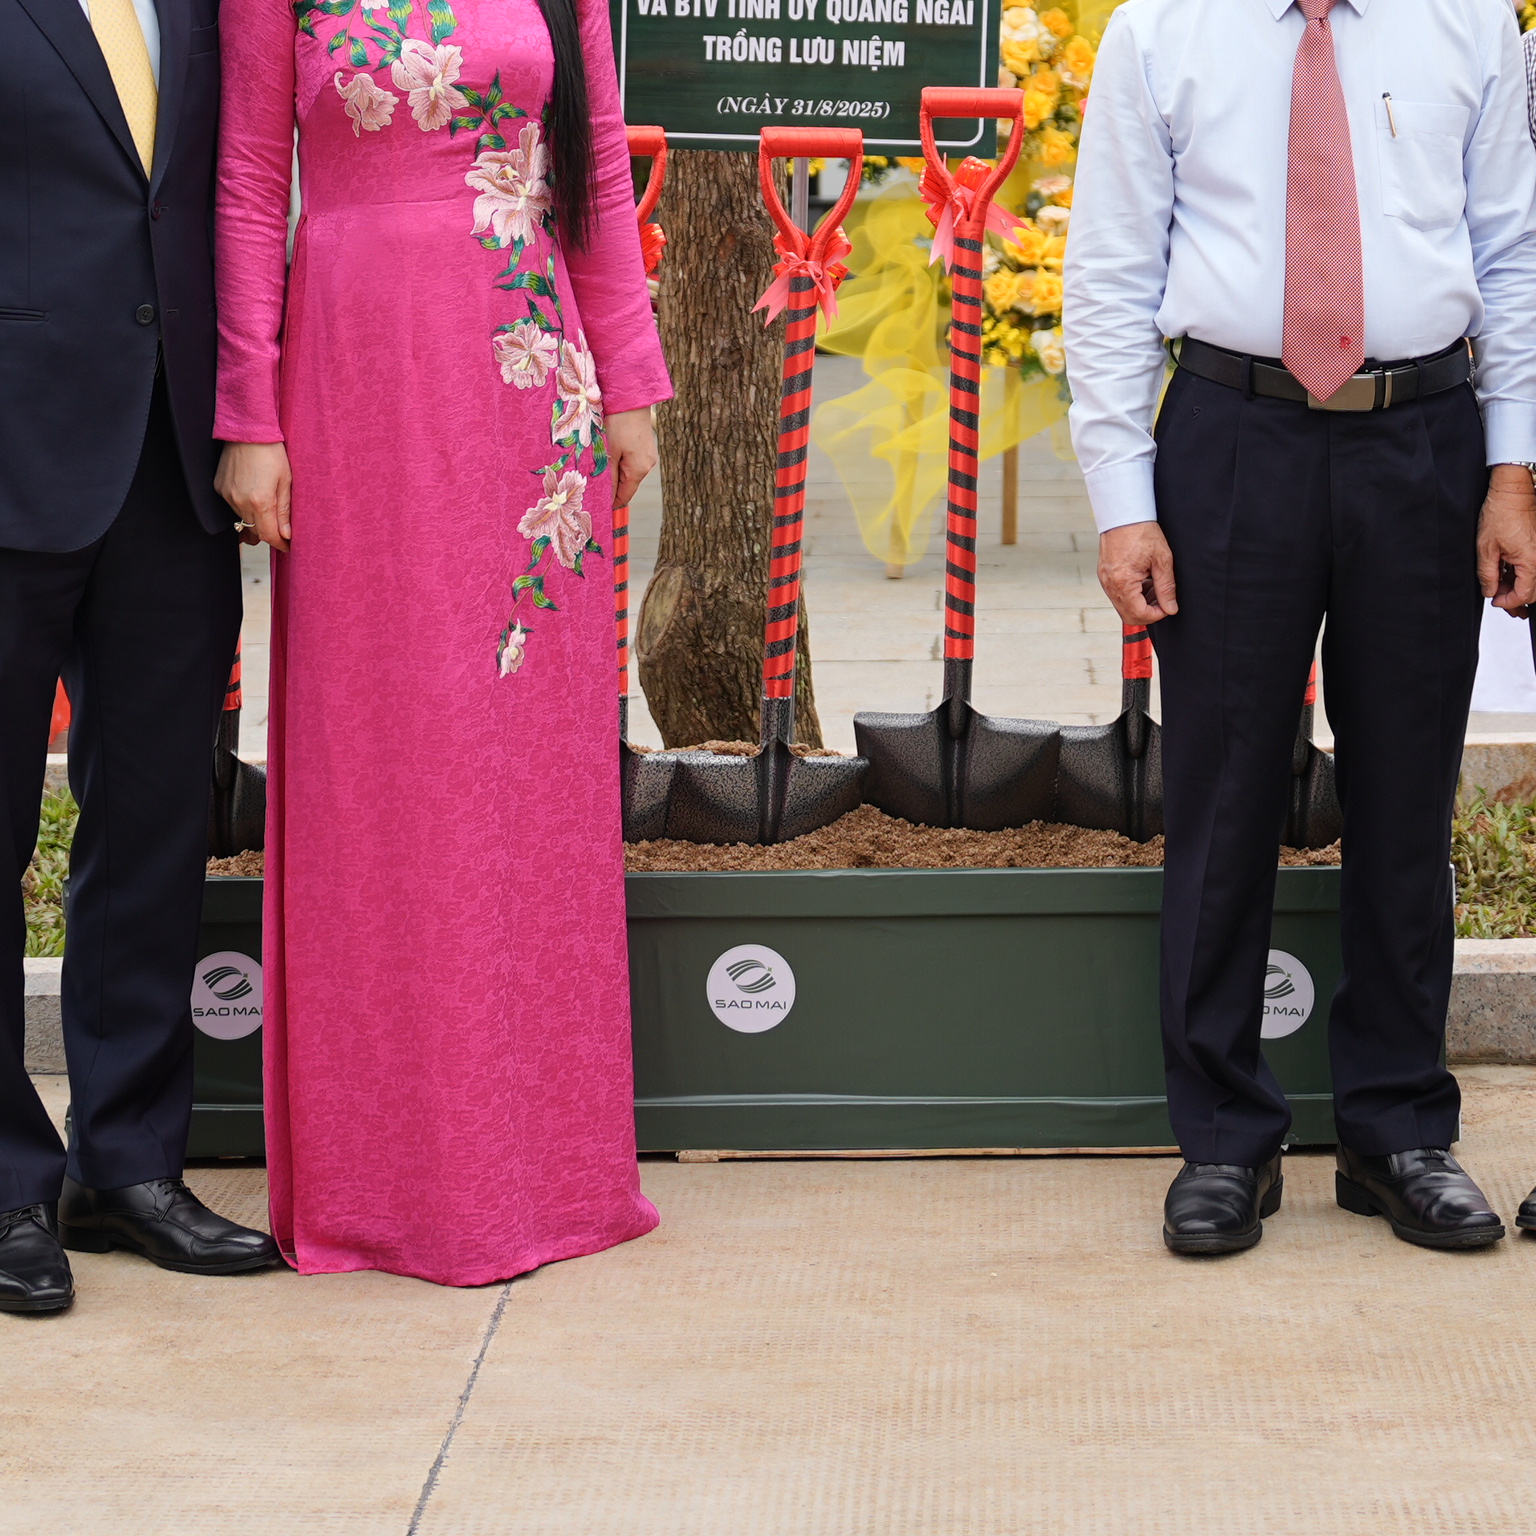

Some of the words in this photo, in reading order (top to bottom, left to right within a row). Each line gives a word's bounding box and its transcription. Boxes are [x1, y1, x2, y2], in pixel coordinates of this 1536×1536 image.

[703, 27, 782, 63] TRỒNG
[790, 35, 835, 64] LƯU
[842, 35, 906, 71] NIỆM
[717, 93, 789, 116] (NGÀY
[791, 98, 891, 119] 31/8/2025)
[715, 999, 753, 1009] SAO
[756, 1000, 787, 1010] MAI
[193, 1007, 230, 1017] SAO
[1273, 1006, 1305, 1017] MAI
